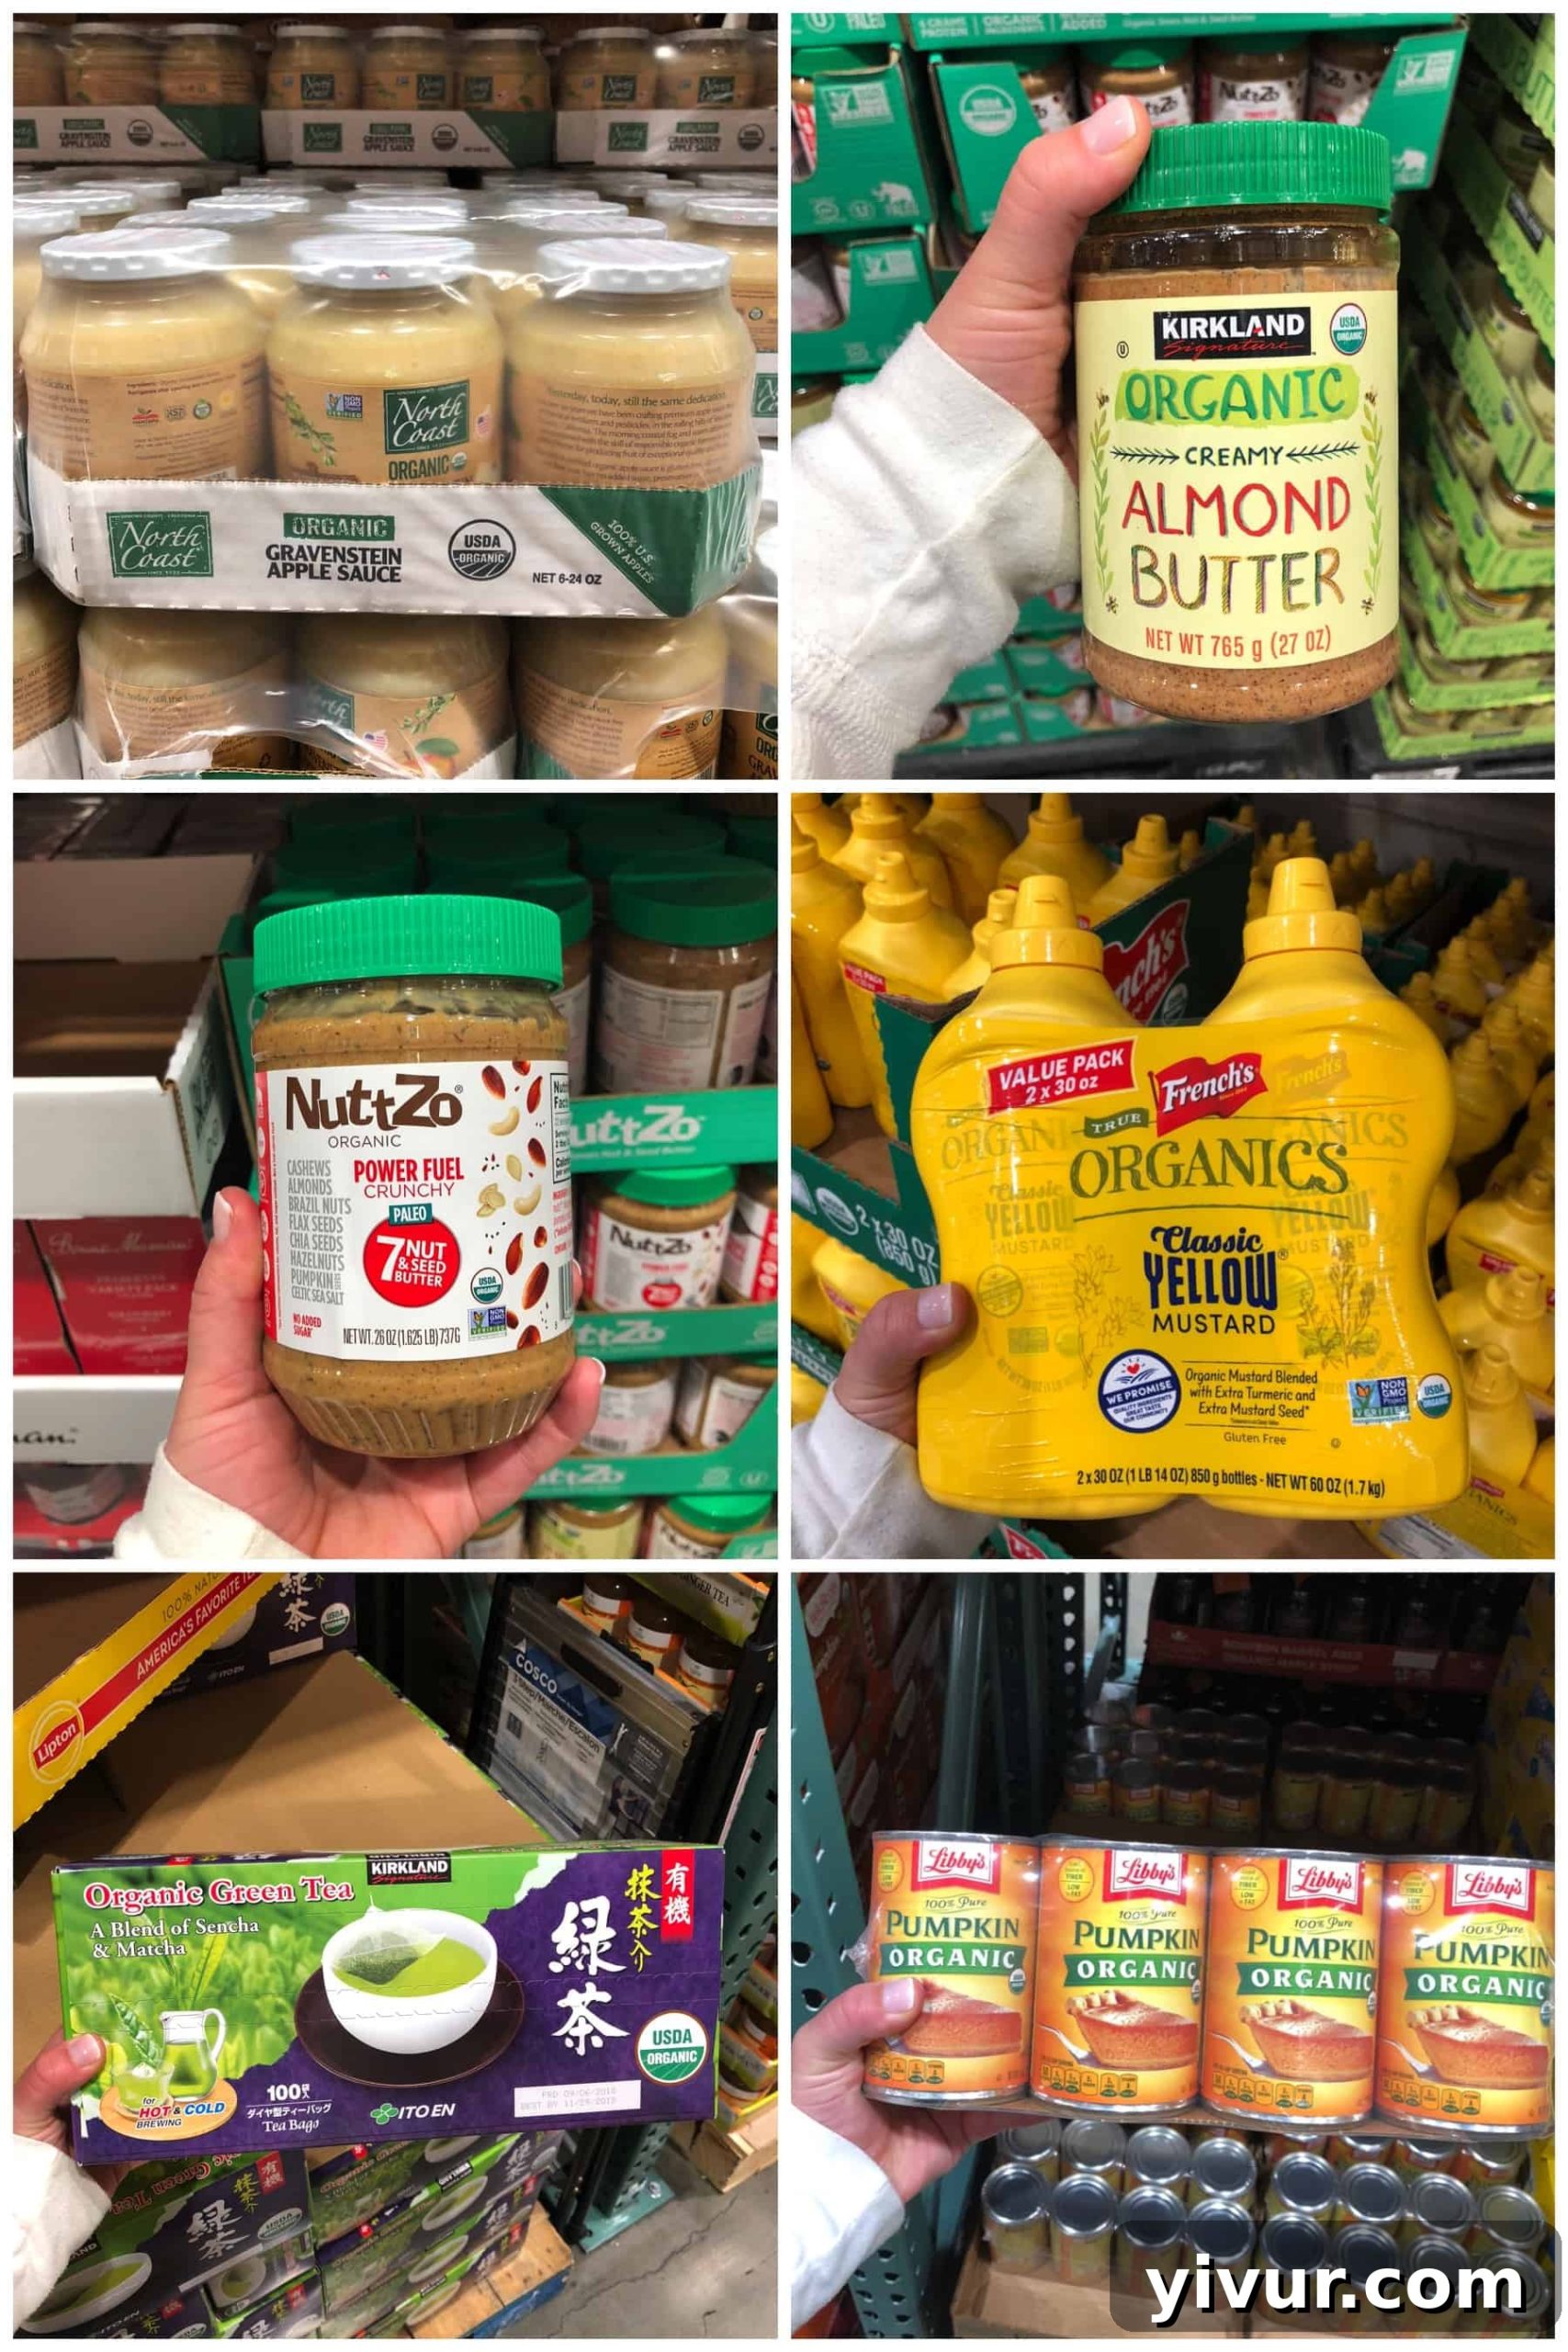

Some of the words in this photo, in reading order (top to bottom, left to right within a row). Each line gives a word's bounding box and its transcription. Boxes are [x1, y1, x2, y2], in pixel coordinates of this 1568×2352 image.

[1162, 313, 1305, 340] KIRKLAND
[1339, 316, 1361, 328] USDA
[1336, 331, 1363, 342] ORGANIC
[1163, 339, 1305, 362] Signature
[623, 396, 640, 406] still
[641, 396, 658, 406] the
[1124, 368, 1346, 422] ORGANIC
[392, 392, 467, 426] North
[392, 418, 459, 447] Coast
[1184, 446, 1284, 467] CREAMY
[388, 455, 449, 481] ORGANIC
[1122, 476, 1351, 537] ALMOND
[118, 521, 205, 548] North
[291, 515, 389, 537] ORGANIC
[464, 534, 502, 549] USDA
[606, 519, 637, 548] 100%
[633, 546, 654, 567] U.S.
[120, 545, 198, 571] Coast
[265, 543, 402, 565] GRAVENSTEIN
[459, 552, 505, 564] ORGANIC
[590, 521, 626, 558] GROWN
[621, 553, 654, 585] APPLES
[266, 561, 333, 581] APPLE
[337, 564, 402, 583] SAUCE
[533, 572, 557, 584] NET
[558, 572, 582, 584] 6-24
[585, 573, 603, 585] OZ
[1131, 544, 1345, 616] BUTTER
[1145, 627, 1173, 650] NET
[1179, 632, 1204, 656] WT
[1211, 635, 1244, 658] 765
[1270, 631, 1299, 657] (27
[1305, 625, 1332, 652] OZ)
[999, 1058, 1068, 1091] VALUE
[1073, 1048, 1125, 1074] PACK
[1055, 1077, 1076, 1096] 30
[1161, 1061, 1255, 1114] French's
[1091, 1113, 1142, 1135] TRUE
[328, 1134, 402, 1148] ORGANIC
[287, 1159, 332, 1177] CASHEWS
[354, 1159, 418, 1183] POWER
[423, 1157, 465, 1182] FUEL
[1070, 1137, 1348, 1198] ORGANICS
[288, 1179, 333, 1196] ALMONDS
[364, 1182, 456, 1200] CRUNCHY
[288, 1197, 321, 1215] BRAZIL
[321, 1197, 352, 1215] NUTS
[392, 1207, 428, 1223] PALEO
[288, 1216, 310, 1233] FLAX
[312, 1216, 344, 1234] SEEDS
[289, 1234, 311, 1250] CHIA
[313, 1235, 344, 1252] SEEDS
[405, 1238, 447, 1261] NUT
[1150, 1226, 1263, 1254] Classic
[290, 1250, 345, 1272] HAZELNUTS
[377, 1235, 405, 1282] 7
[412, 1259, 446, 1274] SEED
[291, 1269, 333, 1289] PUMPKIN
[394, 1272, 443, 1288] BUTTER
[479, 1276, 497, 1285] USDA
[1143, 1250, 1279, 1311] YELLOW
[291, 1286, 310, 1302] CELTIC
[311, 1288, 323, 1303] SEA
[324, 1290, 344, 1306] SALT
[293, 1313, 300, 1324] NO
[301, 1314, 321, 1329] ADDED
[1153, 1313, 1275, 1335] MUSTARD
[344, 1329, 356, 1344] NET
[356, 1329, 373, 1345] WT.
[398, 1329, 423, 1348] (1.625
[424, 1328, 439, 1347] LB)
[439, 1328, 460, 1345] 737G
[1185, 1368, 1226, 1387] Organic
[1228, 1369, 1273, 1384] Mustard
[1276, 1370, 1318, 1385] Blended
[1382, 1379, 1405, 1390] NON
[1106, 1393, 1123, 1406] WE
[1125, 1380, 1173, 1403] PROMISE
[1190, 1385, 1213, 1399] with
[1215, 1386, 1244, 1400] Extra
[1247, 1386, 1293, 1402] Turmeric
[1296, 1388, 1315, 1402] and
[1382, 1388, 1406, 1397] GMO
[1425, 1384, 1445, 1396] USDA
[1113, 1404, 1136, 1414] QUALITY
[1137, 1395, 1172, 1408] INGREDIENTS
[1126, 1408, 1144, 1417] GREAT
[1144, 1403, 1161, 1412] TASTE
[1199, 1402, 1227, 1416] Extra
[1230, 1403, 1276, 1418] Mustard
[1356, 1406, 1407, 1417] VERIFIED
[1224, 1431, 1259, 1444] Gluten
[1262, 1432, 1287, 1445] Free
[1171, 1467, 1189, 1484] OZ)
[1191, 1468, 1211, 1484] 850
[1222, 1470, 1258, 1487] bottles
[1266, 1472, 1288, 1489] NET
[1344, 1478, 1367, 1498] (1.7
[1368, 1480, 1385, 1498] kg)
[161, 1589, 193, 1623] 100%
[136, 1617, 194, 1680] AMERICA'S
[195, 1576, 243, 1625] FAVORITE
[514, 1653, 558, 1695] COSCO
[37, 1722, 77, 1763] Lipton
[371, 1860, 448, 1875] KIRKLAND
[924, 1847, 987, 1873] Libby's
[1117, 1858, 1176, 1886] Libby's
[1292, 1867, 1353, 1894] Libby's
[84, 1880, 204, 1915] Organic
[209, 1878, 297, 1905] Green
[300, 1875, 355, 1901] Tea
[663, 1862, 692, 1926] 有機
[1459, 1871, 1523, 1899] Libby's
[925, 1898, 955, 1909] 100%
[958, 1895, 987, 1908] Pure
[625, 1863, 662, 1973] 抹茶入り
[886, 1910, 1020, 1939] PUMPKIN
[1119, 1909, 1148, 1920] 100%
[1294, 1918, 1325, 1928] 100%
[1327, 1916, 1353, 1929] Pure
[110, 1921, 165, 1939] Blend
[170, 1917, 192, 1935] of
[195, 1916, 259, 1935] Sencha
[1074, 1920, 1200, 1951] PUMPKIN
[1461, 1925, 1493, 1935] 100%
[1495, 1923, 1525, 1936] Pure
[117, 1939, 186, 1958] Matcha
[1247, 1928, 1376, 1961] PUMPKIN
[1413, 1933, 1551, 1968] PUMPKIN
[889, 1947, 1015, 1970] ORGANIC
[548, 1895, 632, 2056] 緑茶
[1077, 1959, 1196, 1981] ORGANIC
[1250, 1968, 1371, 1992] ORGANIC
[1417, 1973, 1545, 2000] ORGANIC
[652, 2029, 693, 2046] USDA
[647, 2050, 698, 2065] ORGANIC
[139, 2106, 171, 2119] HOT
[185, 2101, 226, 2116] COLD
[142, 2097, 155, 2105] for
[398, 2105, 431, 2120] ITO
[432, 2103, 456, 2118] EN
[136, 2119, 182, 2129] BREWING
[263, 2120, 288, 2132] Tea
[289, 2119, 320, 2133] Bags
